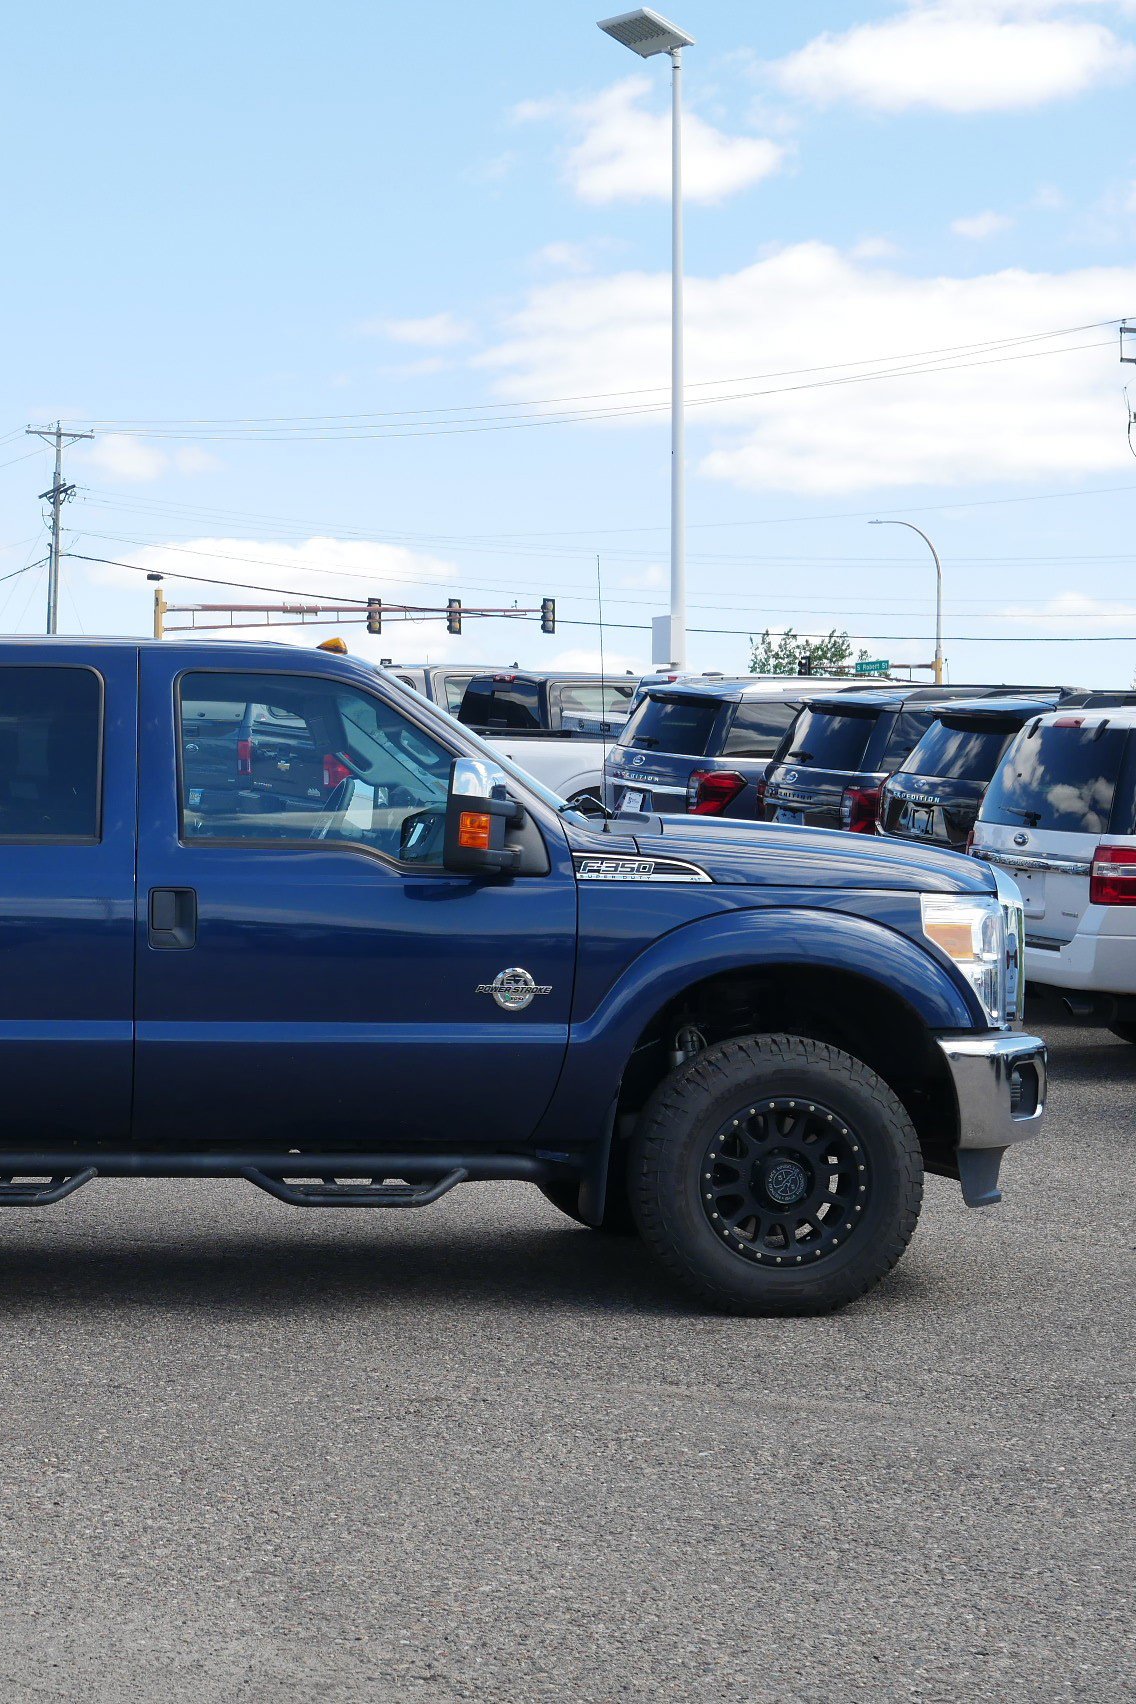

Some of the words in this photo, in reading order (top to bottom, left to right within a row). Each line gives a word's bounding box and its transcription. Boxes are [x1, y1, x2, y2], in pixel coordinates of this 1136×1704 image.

[894, 791, 940, 803] EXPEDITION
[476, 985, 512, 994] POWER
[512, 985, 553, 995] STROKE
